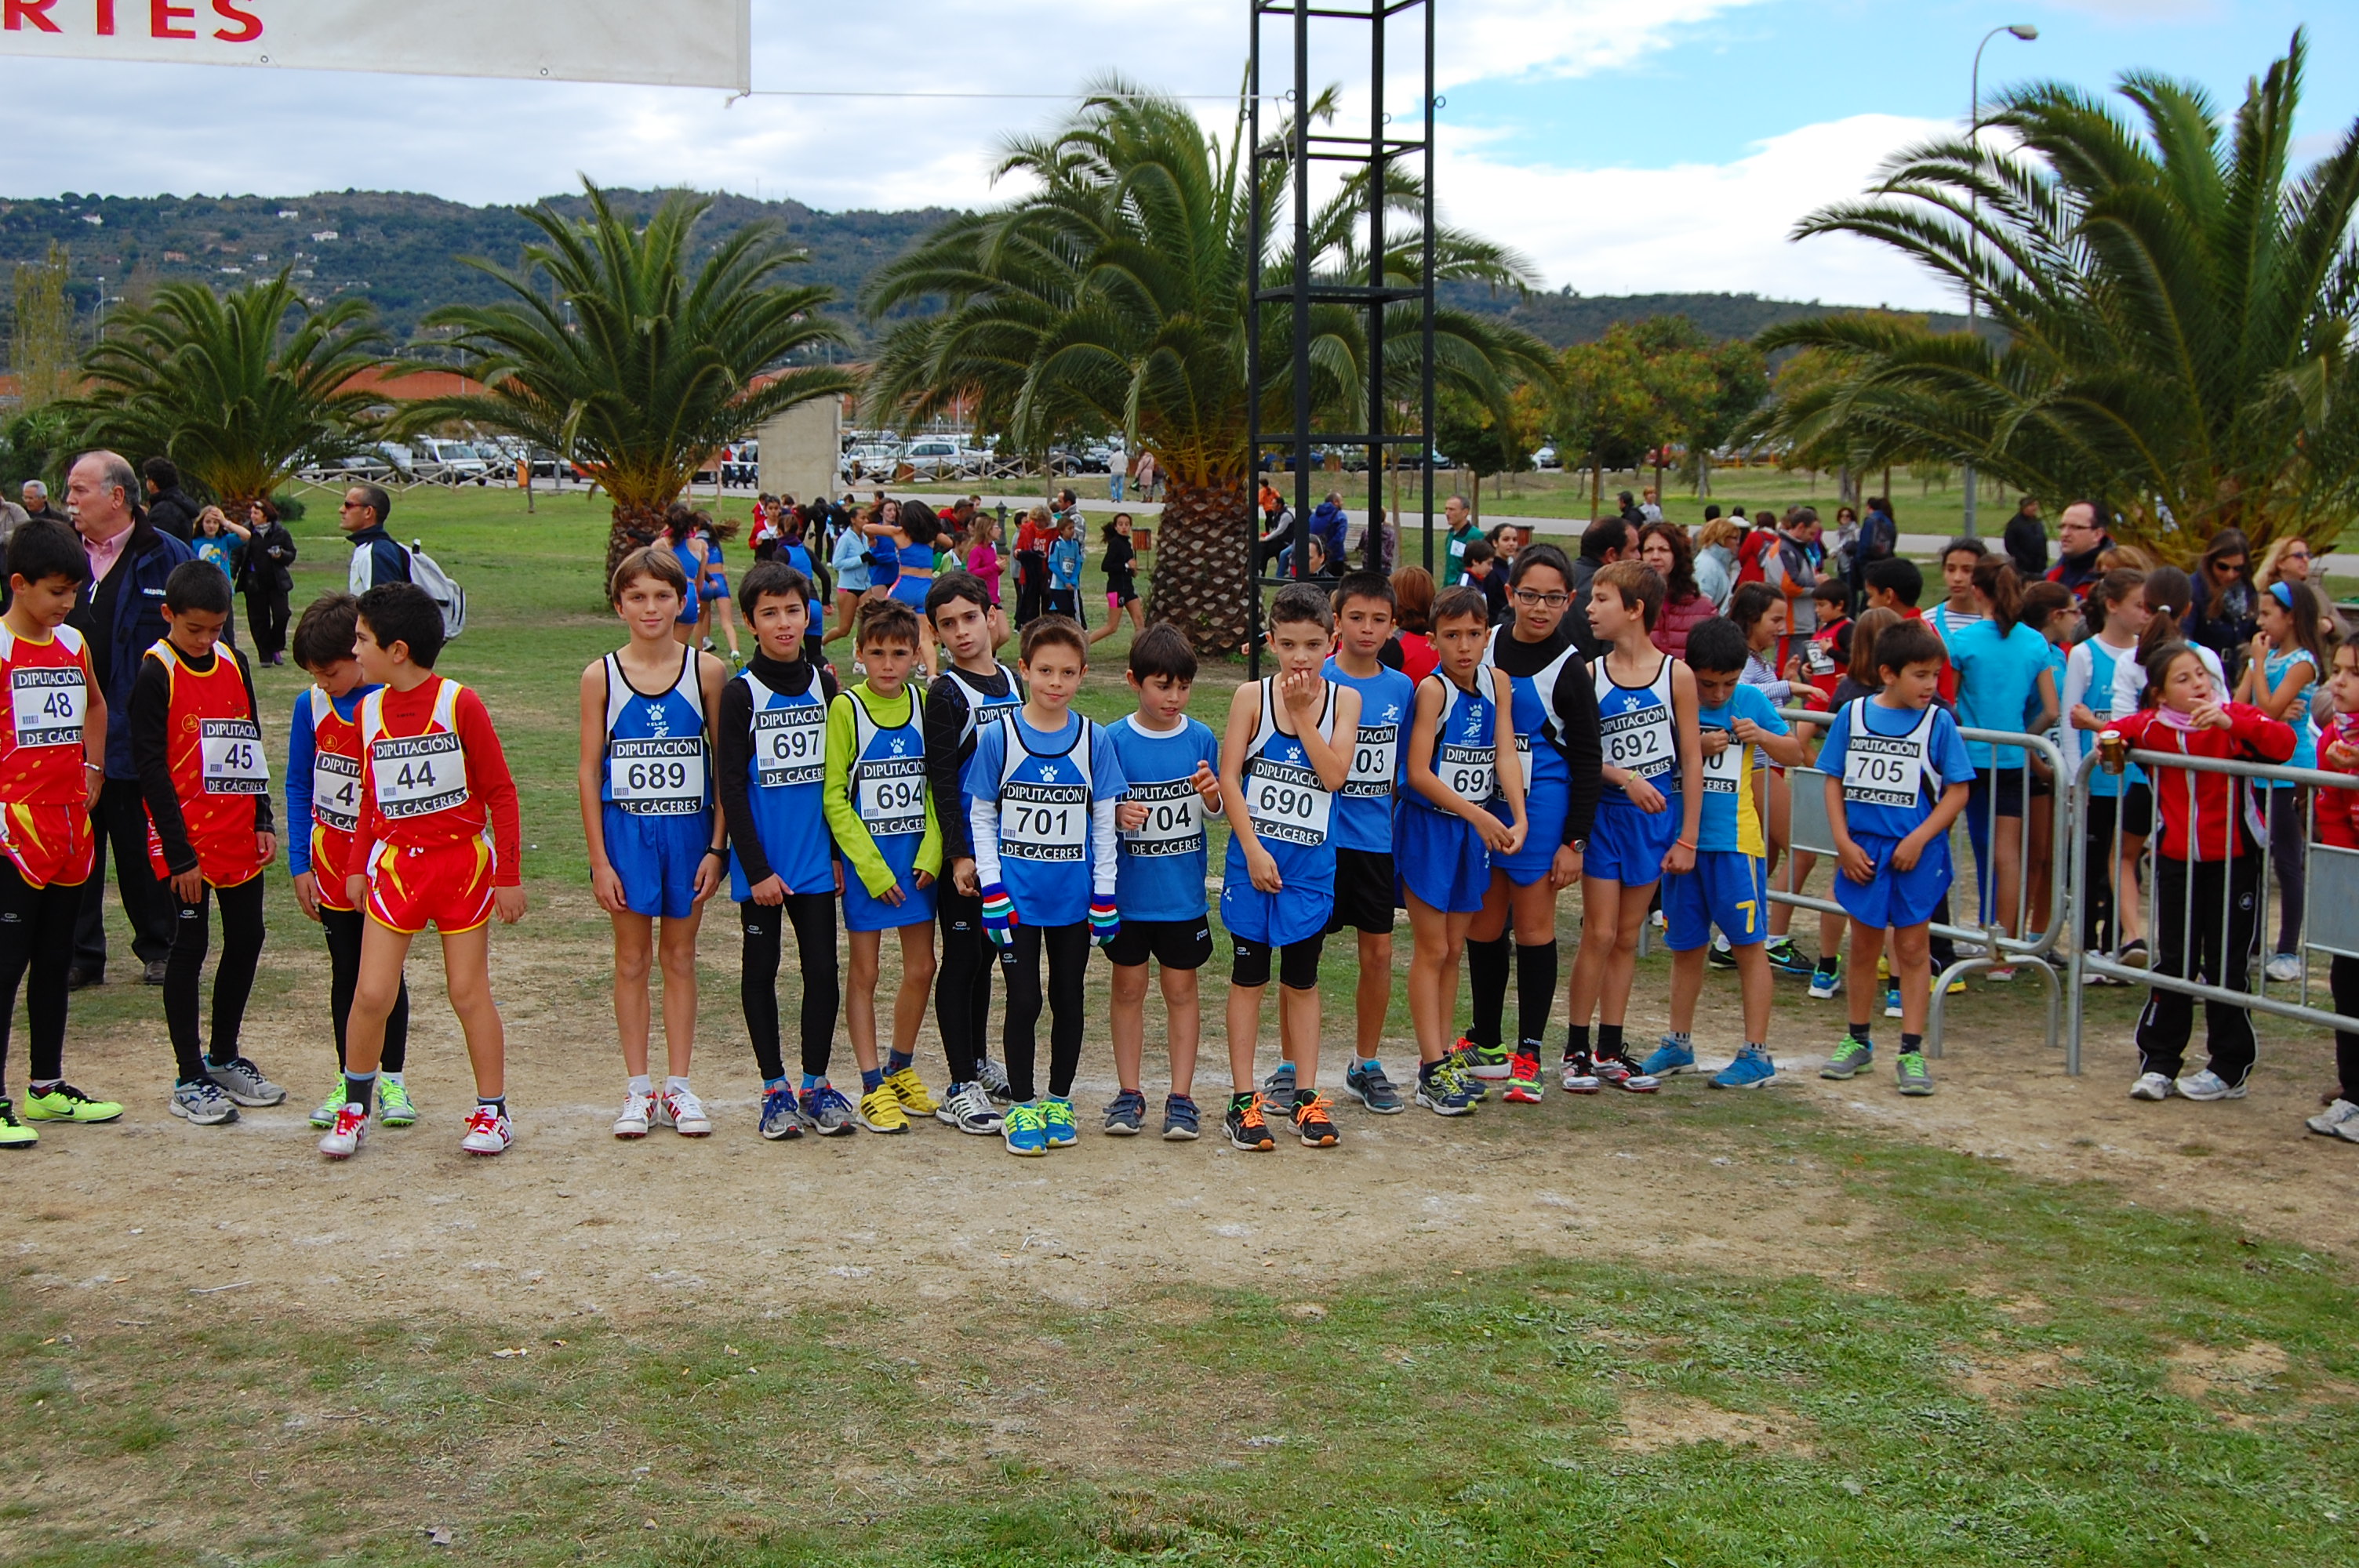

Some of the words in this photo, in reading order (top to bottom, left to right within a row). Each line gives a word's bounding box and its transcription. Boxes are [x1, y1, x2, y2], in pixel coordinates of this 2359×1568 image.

[18, 670, 83, 687] DIPUTACIÓN
[43, 692, 73, 719] 48
[206, 723, 258, 739] DIPUTACIÓ
[1601, 708, 1665, 734] DIPUTACIÓN
[27, 732, 42, 745] DE
[376, 735, 456, 758] DIPUTACIÓN
[616, 740, 698, 757] DIPUTACIÓN
[772, 730, 820, 760] 697
[1612, 730, 1659, 760] 692
[1850, 738, 1918, 756] DIPUTACIÓN
[225, 743, 253, 769] 45
[1356, 748, 1384, 774] 03
[1637, 759, 1670, 776] ÁCERES
[397, 760, 436, 789] 44
[628, 762, 685, 789] 689
[766, 773, 783, 784] DE
[1453, 768, 1492, 793] 693
[1857, 757, 1904, 783] 705
[209, 781, 220, 791] DE
[224, 779, 264, 792] CÁCERES
[336, 782, 362, 806] 4
[876, 781, 924, 810] 694
[1007, 786, 1084, 801] DIPUTACIÓN
[1344, 781, 1389, 795] CÁCERES
[1847, 788, 1859, 800] DE
[1859, 787, 1912, 805] CÁCERES
[384, 805, 400, 817] DE
[402, 791, 463, 815] CÁCERES
[621, 802, 636, 813] DE
[640, 798, 697, 813] CÁCERES
[1260, 785, 1313, 818] 690
[320, 810, 333, 824] DE
[870, 822, 886, 834] DE
[1016, 806, 1067, 836] 701
[1140, 802, 1192, 832] 704
[1263, 823, 1319, 844] CÁCERES
[1006, 845, 1020, 856] DE
[1023, 845, 1078, 859] CÁCERES
[1132, 844, 1146, 855] DE
[1150, 839, 1201, 854] CÁCERES
[1736, 900, 1756, 934] 7
